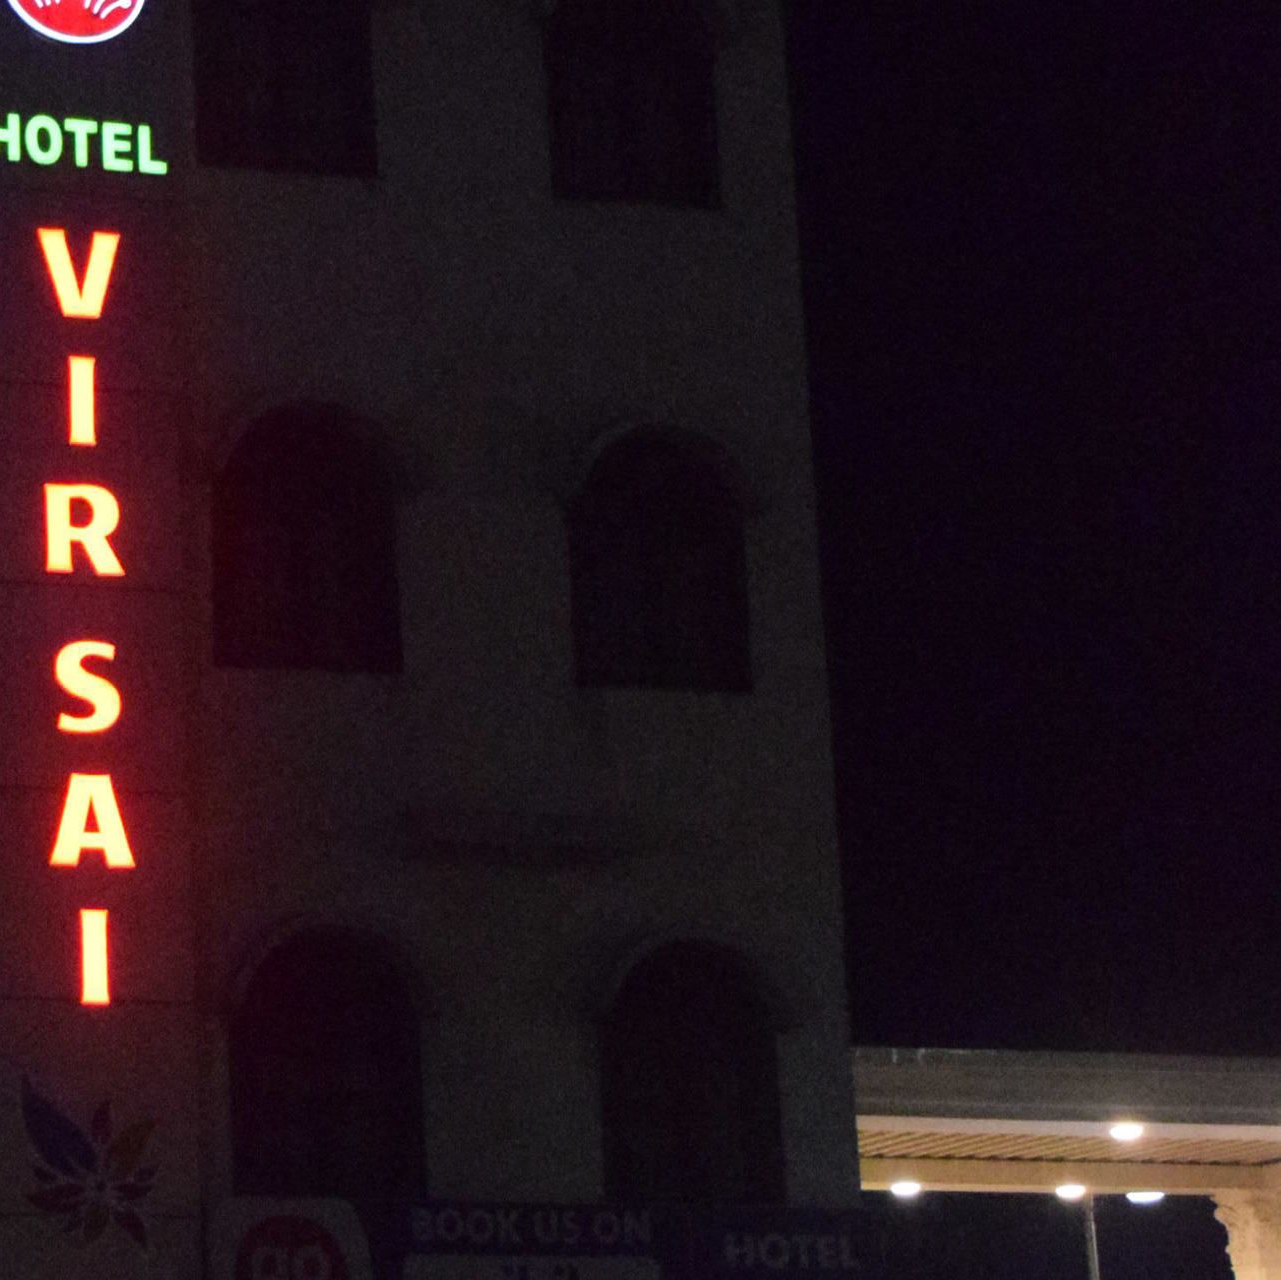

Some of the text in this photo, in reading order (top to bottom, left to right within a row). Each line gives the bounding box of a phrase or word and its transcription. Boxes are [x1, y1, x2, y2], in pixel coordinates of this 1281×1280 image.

[411, 1208, 652, 1246] BOOK US ON
[723, 1233, 861, 1270] HOTEL
